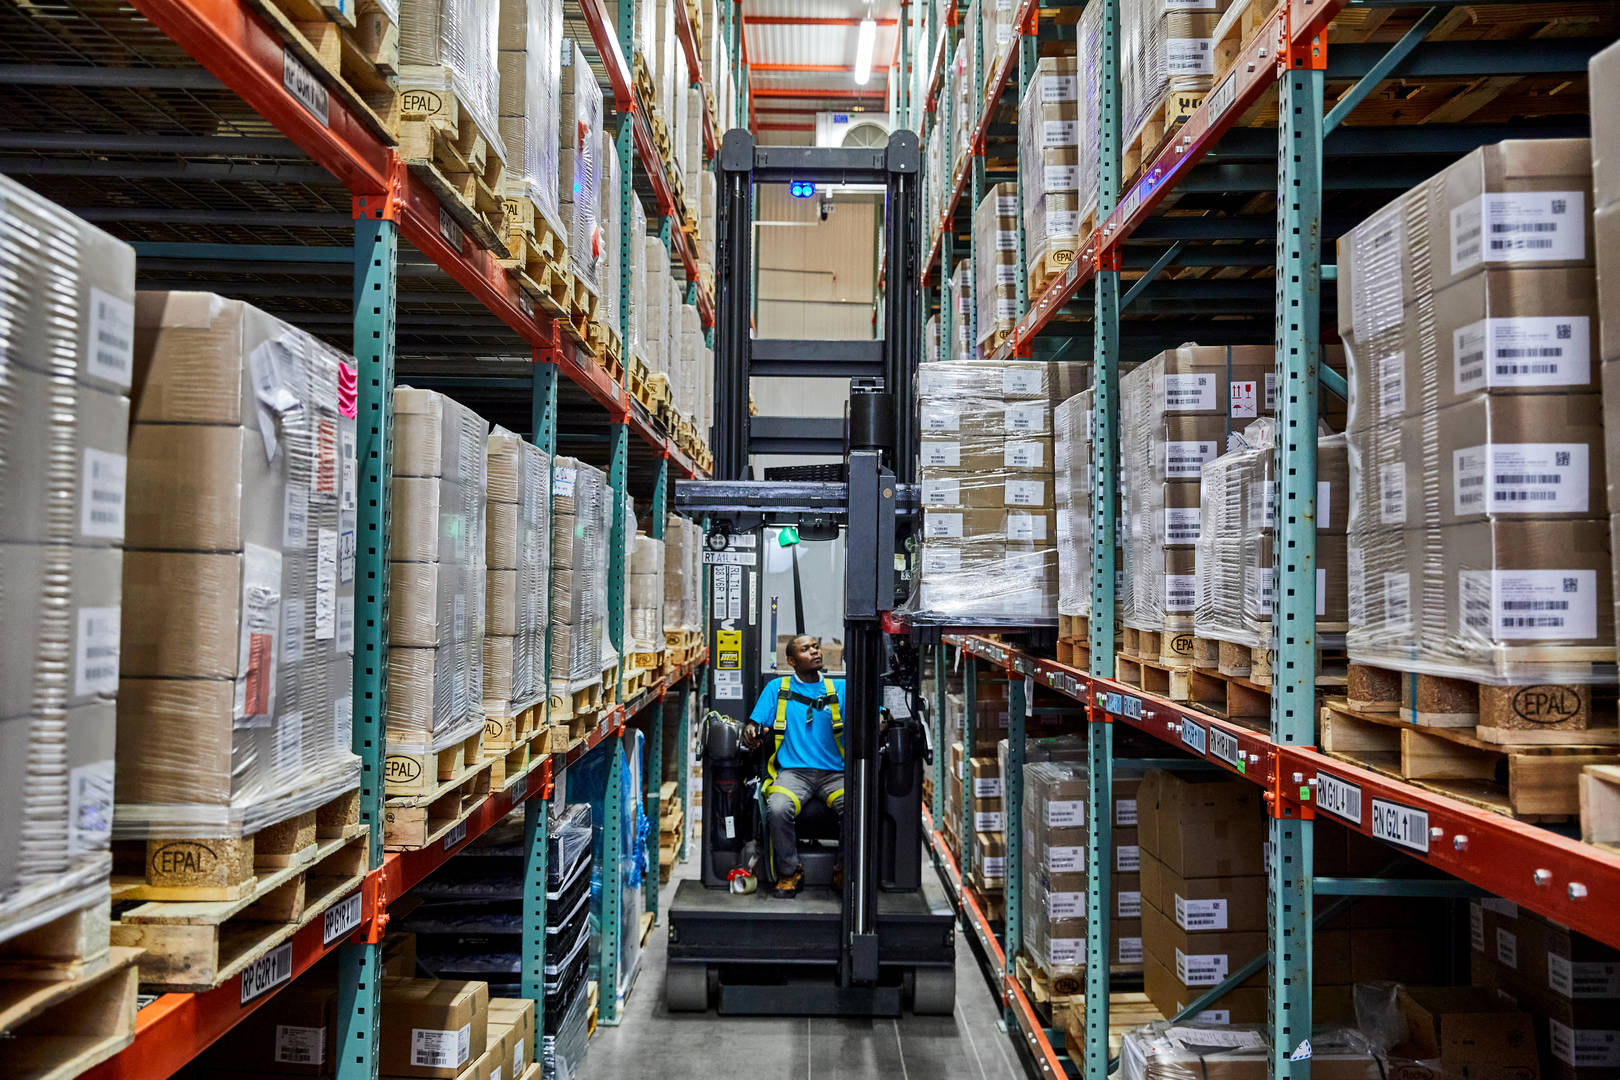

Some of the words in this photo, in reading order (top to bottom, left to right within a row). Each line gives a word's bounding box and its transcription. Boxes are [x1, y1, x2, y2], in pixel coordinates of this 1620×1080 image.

[404, 95, 434, 111] EPAL
[503, 203, 518, 215] PAL
[1057, 253, 1072, 262] EPAL
[705, 553, 714, 562] RT
[1176, 639, 1194, 651] EPA
[1525, 691, 1571, 715] EPAL
[484, 724, 497, 736] AL
[386, 761, 414, 777] EPAL
[1318, 777, 1326, 805] RN
[1328, 782, 1339, 811] G1L
[1374, 805, 1384, 835] RN
[1386, 808, 1401, 840] G2L
[162, 851, 207, 873] EPAL
[325, 911, 334, 939] RP
[334, 904, 347, 934] G1R
[242, 964, 254, 999] RP
[256, 957, 270, 991] G2R
